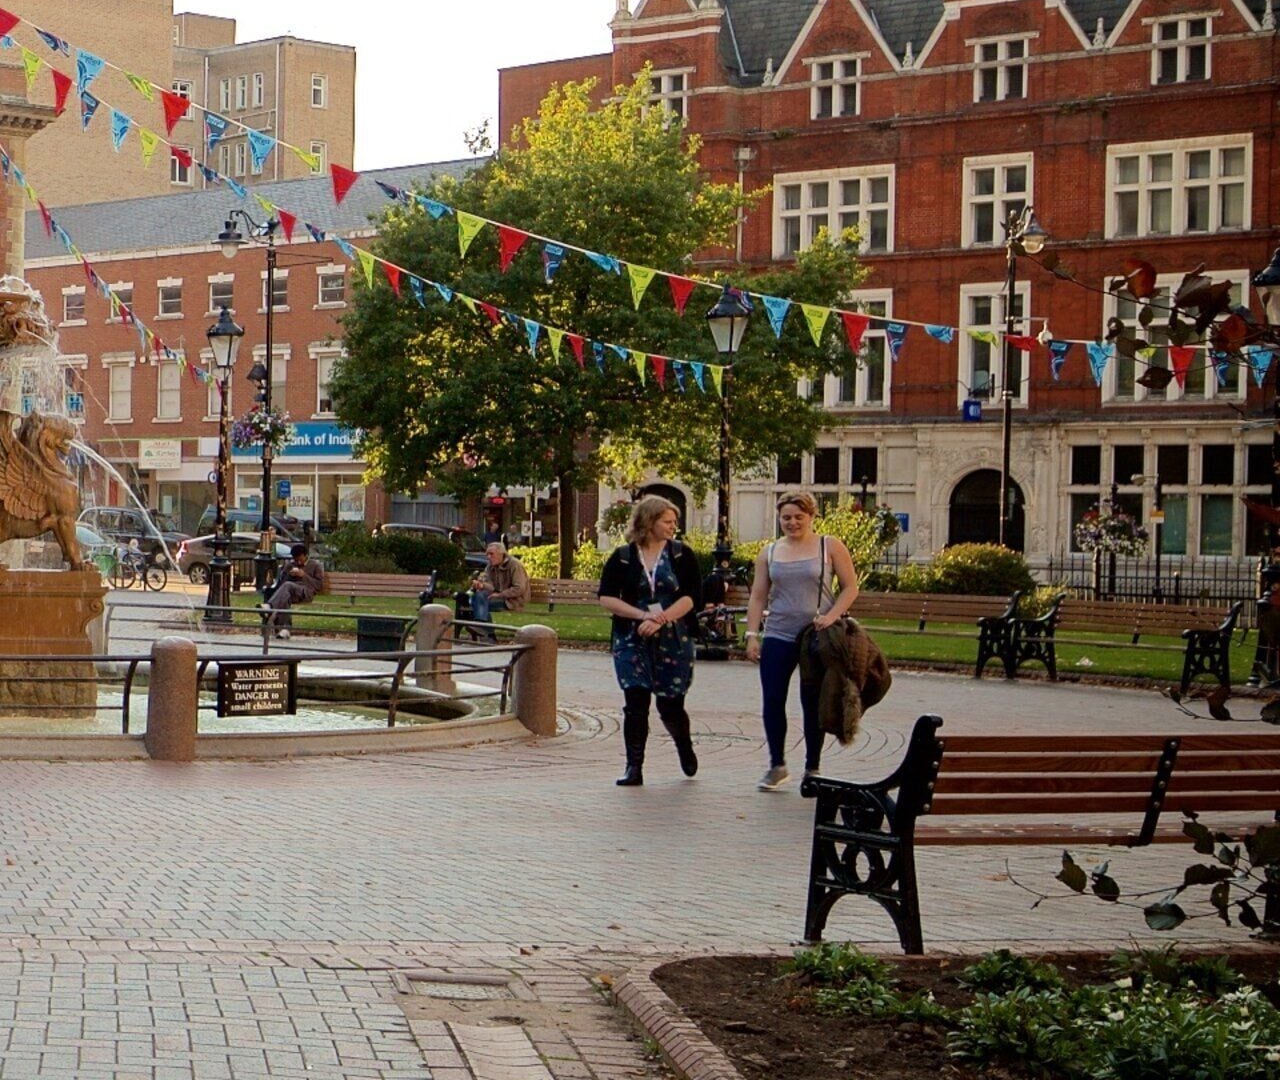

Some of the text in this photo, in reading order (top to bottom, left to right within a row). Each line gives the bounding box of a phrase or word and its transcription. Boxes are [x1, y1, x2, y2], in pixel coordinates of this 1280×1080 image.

[314, 433, 326, 445] of
[235, 669, 279, 678] WARNING
[231, 682, 283, 691] Water presents
[235, 692, 269, 700] DANGER
[231, 701, 282, 711] small children
